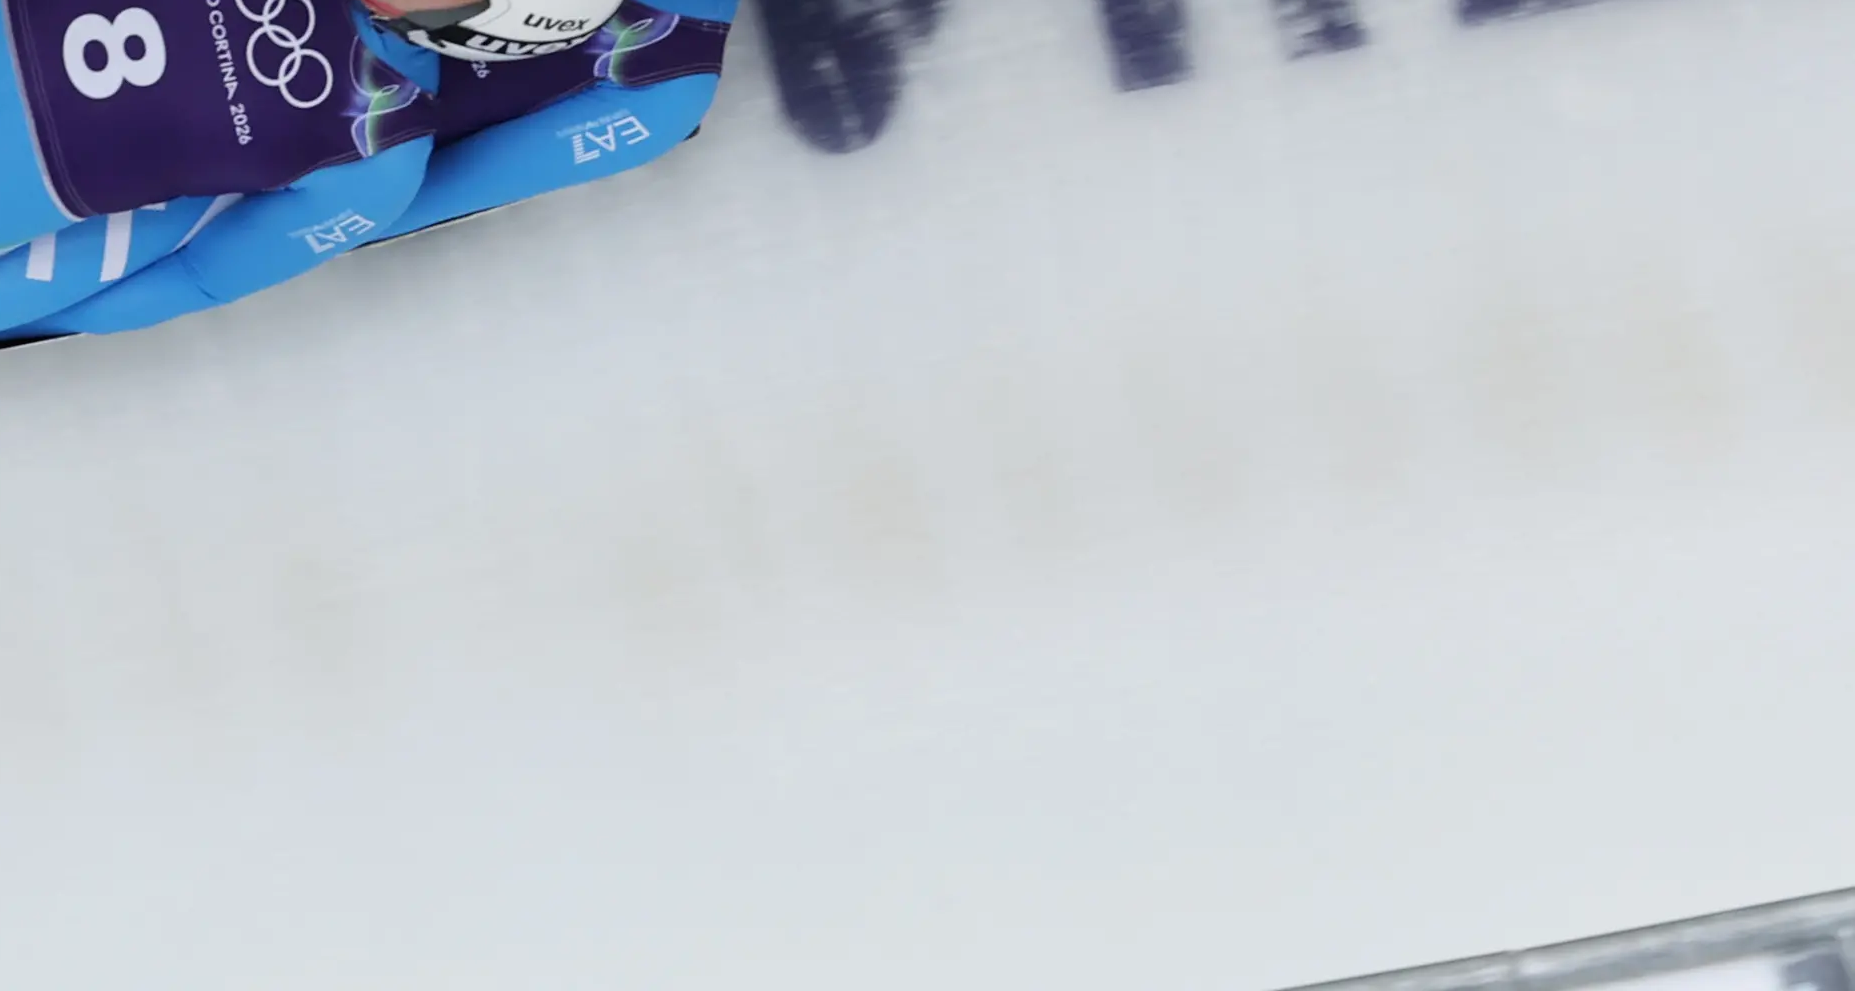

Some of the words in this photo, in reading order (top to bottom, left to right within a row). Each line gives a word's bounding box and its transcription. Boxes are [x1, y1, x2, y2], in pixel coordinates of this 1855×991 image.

[523, 12, 591, 33] uvex
[62, 6, 167, 100] 8
[471, 59, 491, 78] 26
[208, 9, 240, 101] CORTINA
[229, 103, 253, 146] 2026
[571, 115, 650, 165] EA7
[304, 214, 376, 254] EA7
